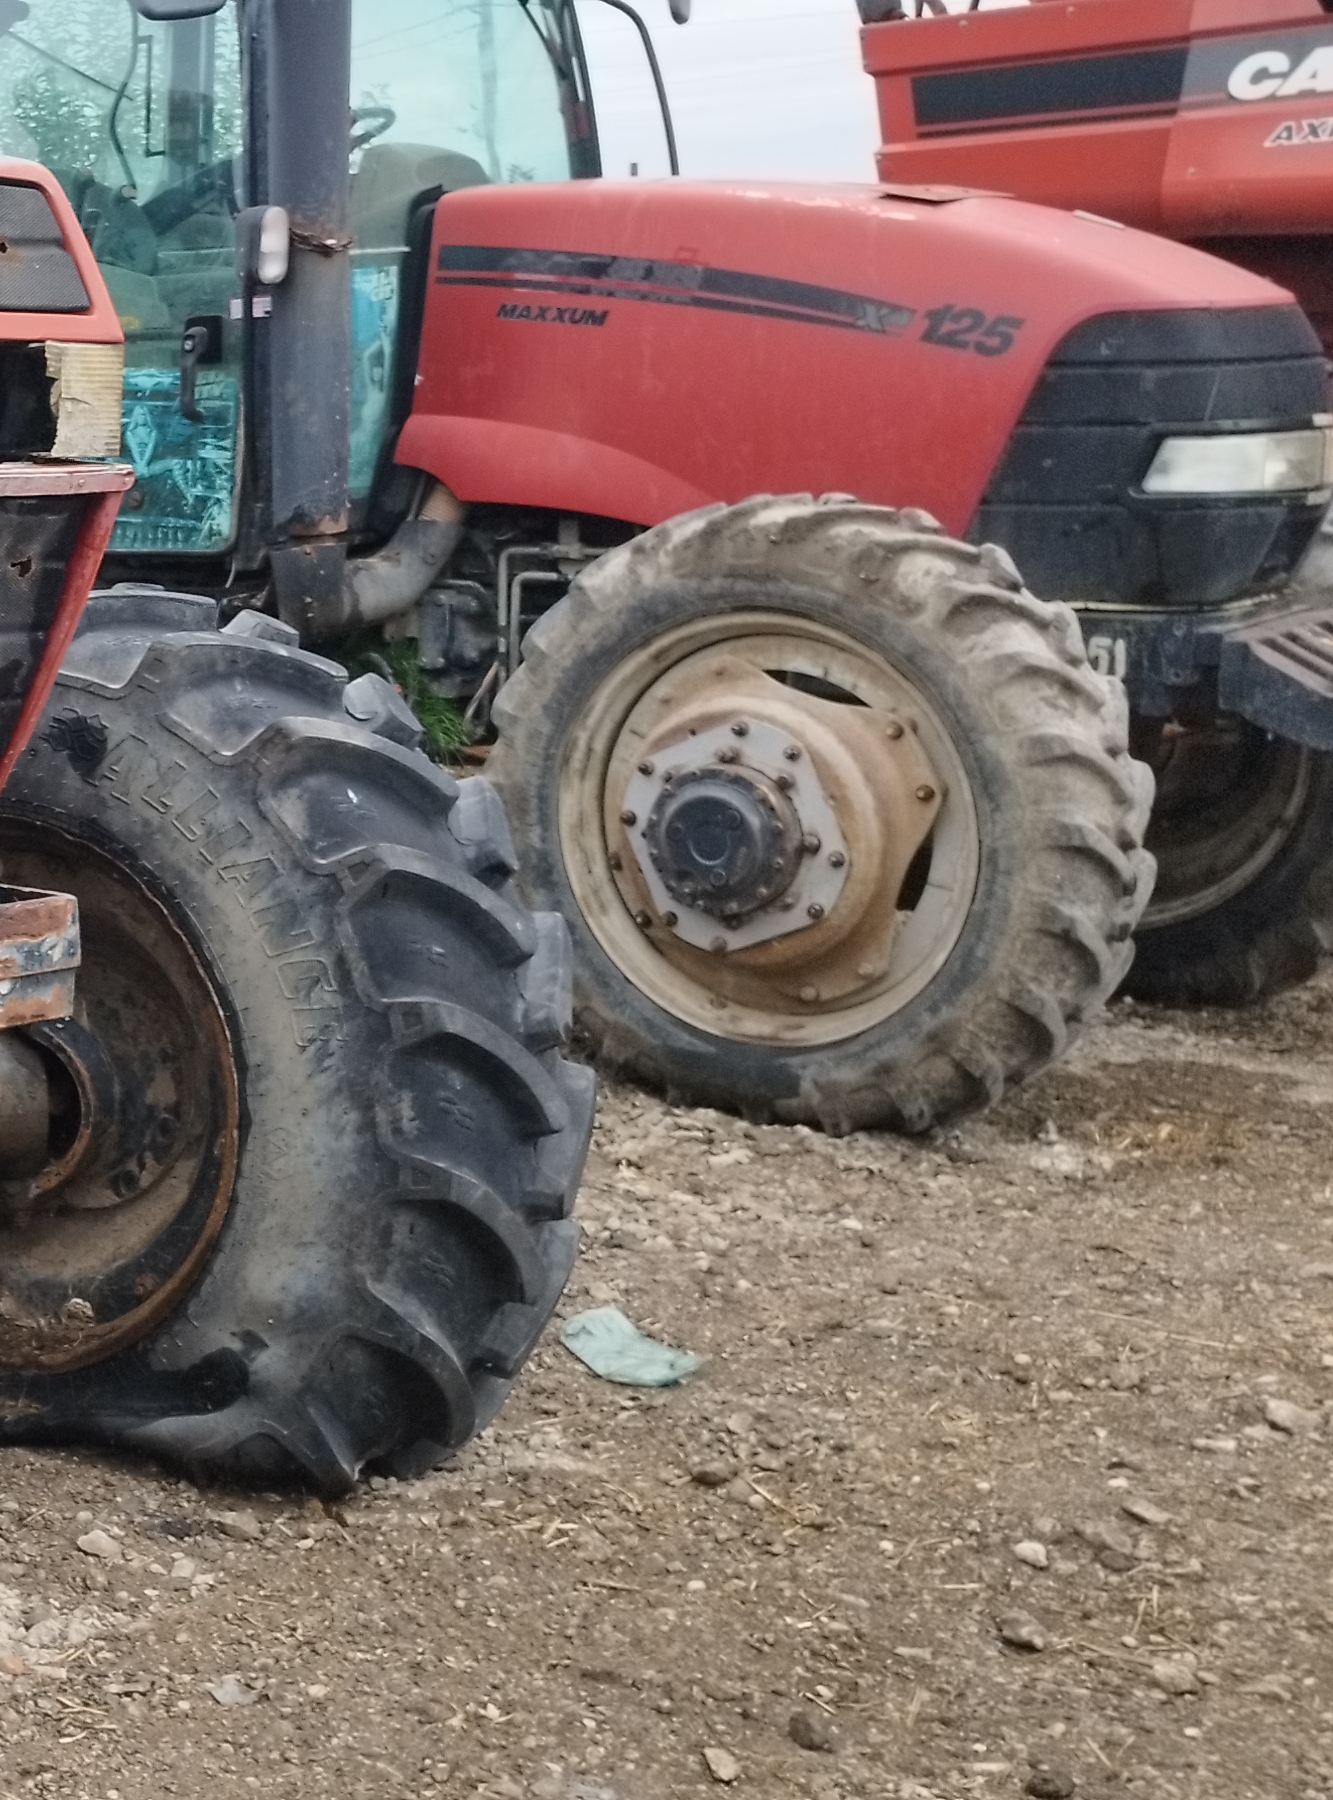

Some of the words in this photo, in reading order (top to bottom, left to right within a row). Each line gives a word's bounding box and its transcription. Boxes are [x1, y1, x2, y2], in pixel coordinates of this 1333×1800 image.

[497, 303, 610, 327] MAXXUM
[920, 303, 1025, 357] 125
[83, 730, 349, 1048] ALLIANCE
